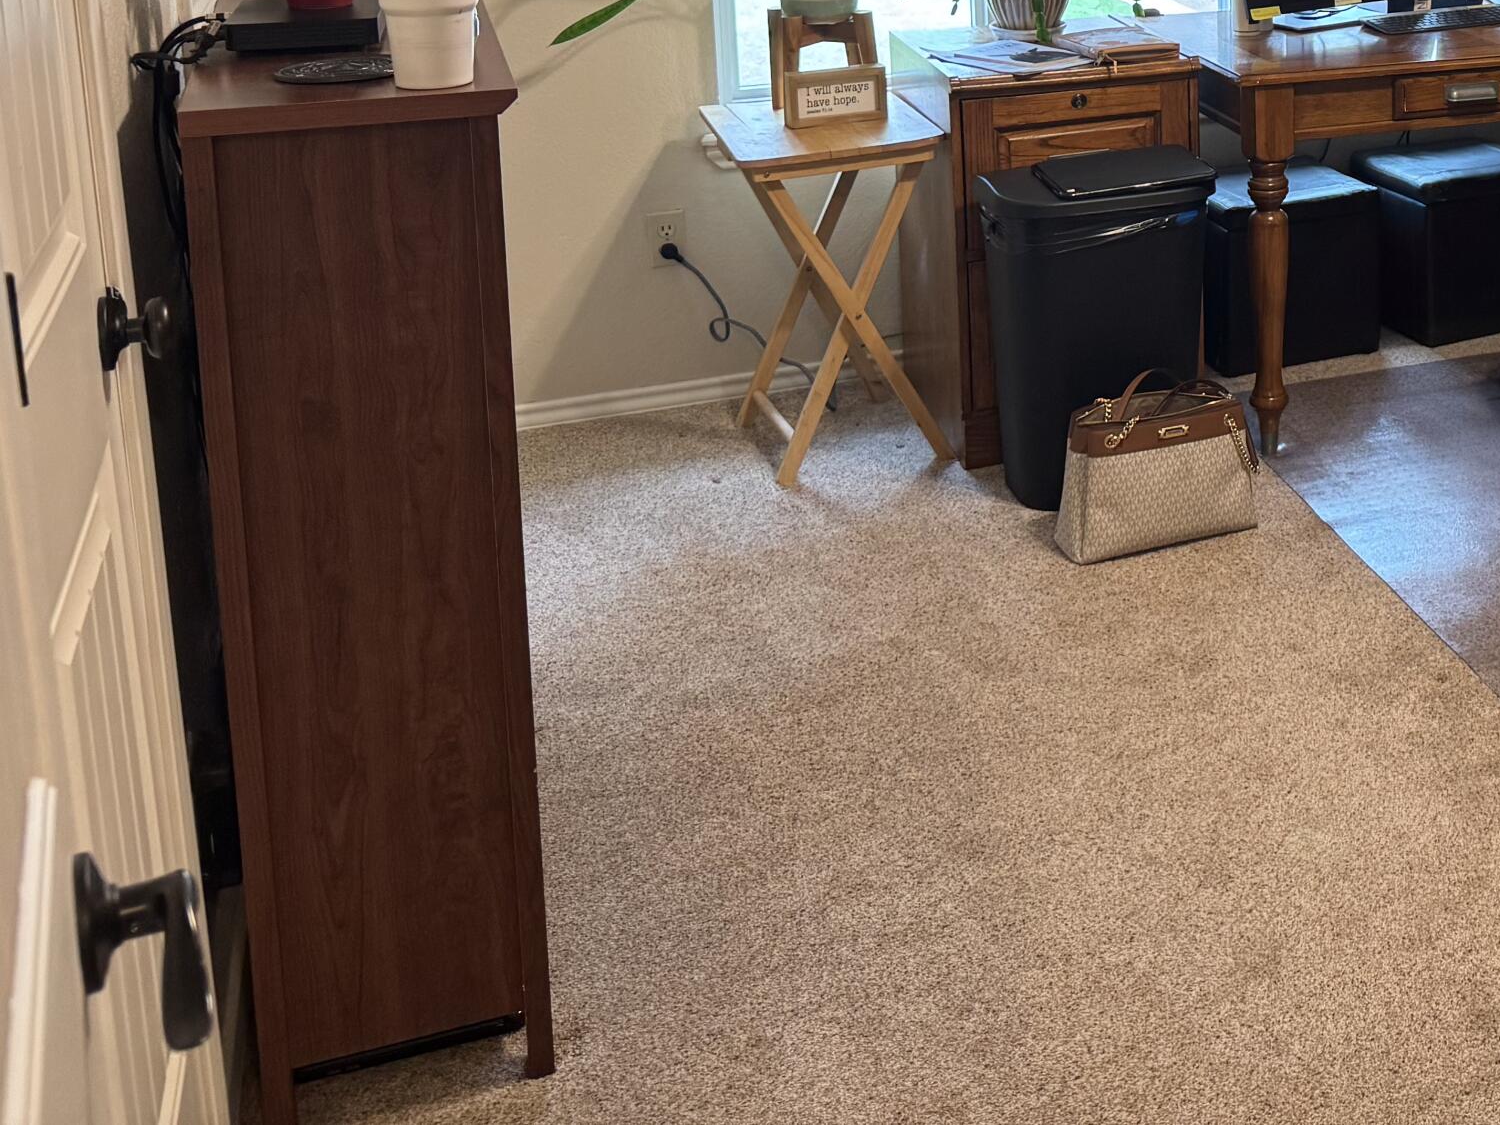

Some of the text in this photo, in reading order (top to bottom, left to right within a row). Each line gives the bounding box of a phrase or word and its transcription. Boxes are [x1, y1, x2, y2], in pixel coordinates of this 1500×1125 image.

[806, 82, 870, 96] I will always
[806, 95, 860, 108] have hope.
